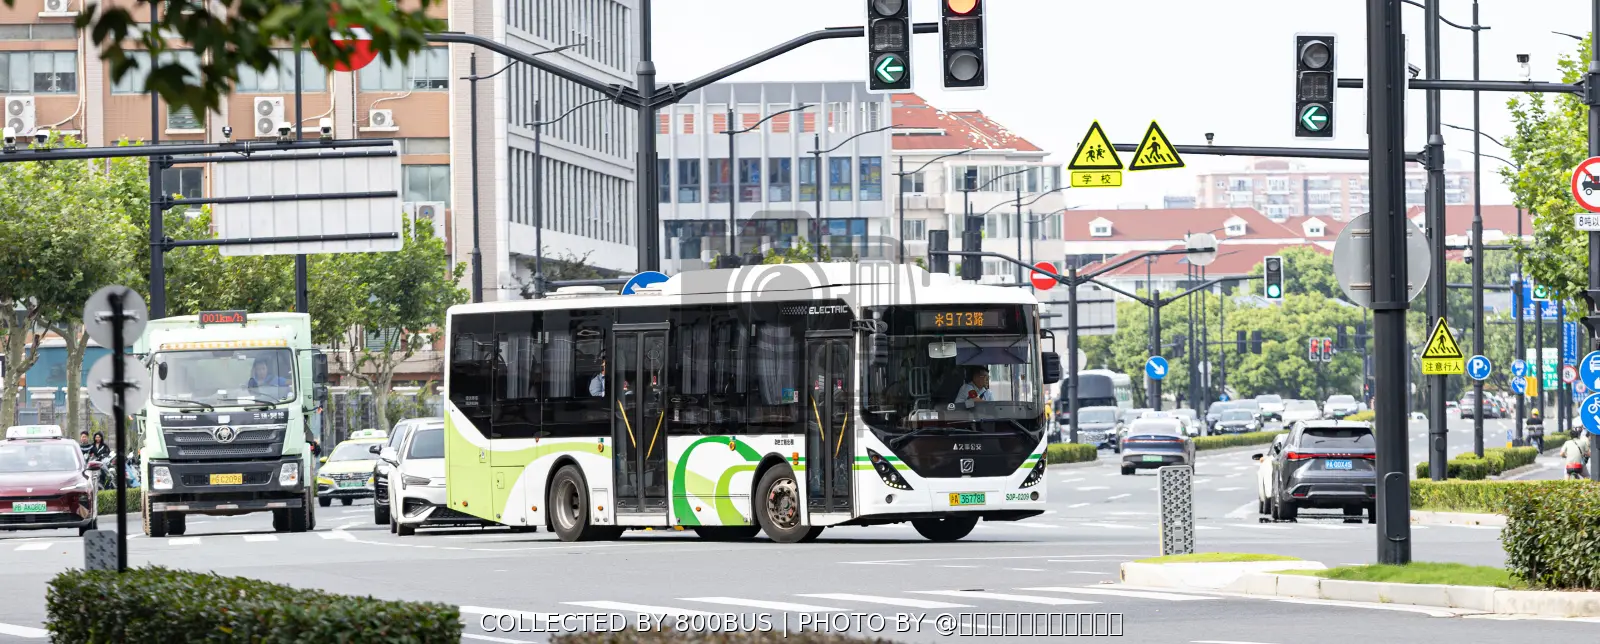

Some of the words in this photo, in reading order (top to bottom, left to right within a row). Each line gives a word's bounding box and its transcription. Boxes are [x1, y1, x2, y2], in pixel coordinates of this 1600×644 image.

[1082, 174, 1111, 184] 学校
[808, 304, 848, 315] ELECTRIC
[202, 312, 244, 323] 001km/h
[1425, 362, 1461, 372] 注意行人
[1473, 359, 1484, 375] P
